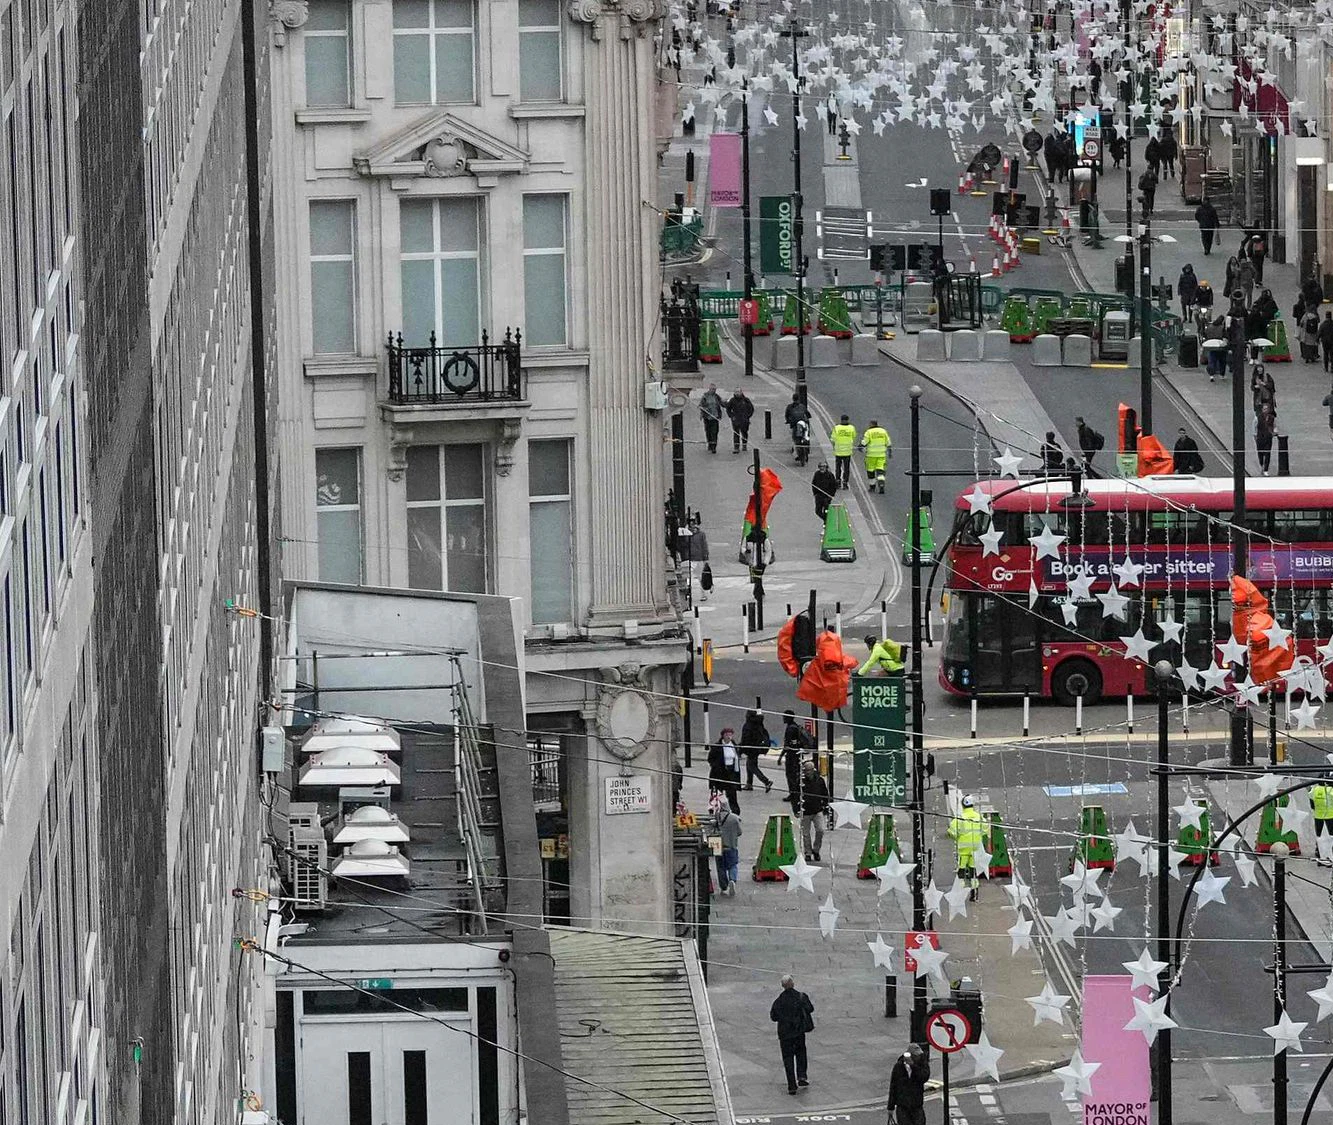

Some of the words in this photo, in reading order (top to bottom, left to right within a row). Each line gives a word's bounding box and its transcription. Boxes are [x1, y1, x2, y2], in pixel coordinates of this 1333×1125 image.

[778, 202, 791, 262] OXFORD
[1050, 560, 1094, 576] Book
[1097, 564, 1109, 575] a
[1112, 562, 1161, 576] ser
[1165, 559, 1216, 575] sitter
[992, 566, 1014, 582] Go
[1051, 596, 1067, 605] 453
[860, 685, 899, 697] MORE
[860, 697, 899, 708] SPACE
[609, 779, 630, 788] JOHN
[866, 774, 894, 785] LESS
[855, 784, 905, 797] TRAFFC
[609, 796, 636, 806] STREET
[638, 796, 648, 804] W1
[1085, 1103, 1134, 1116] MAYOR
[1135, 1102, 1147, 1110] OF
[794, 1114, 851, 1123] LOOK
